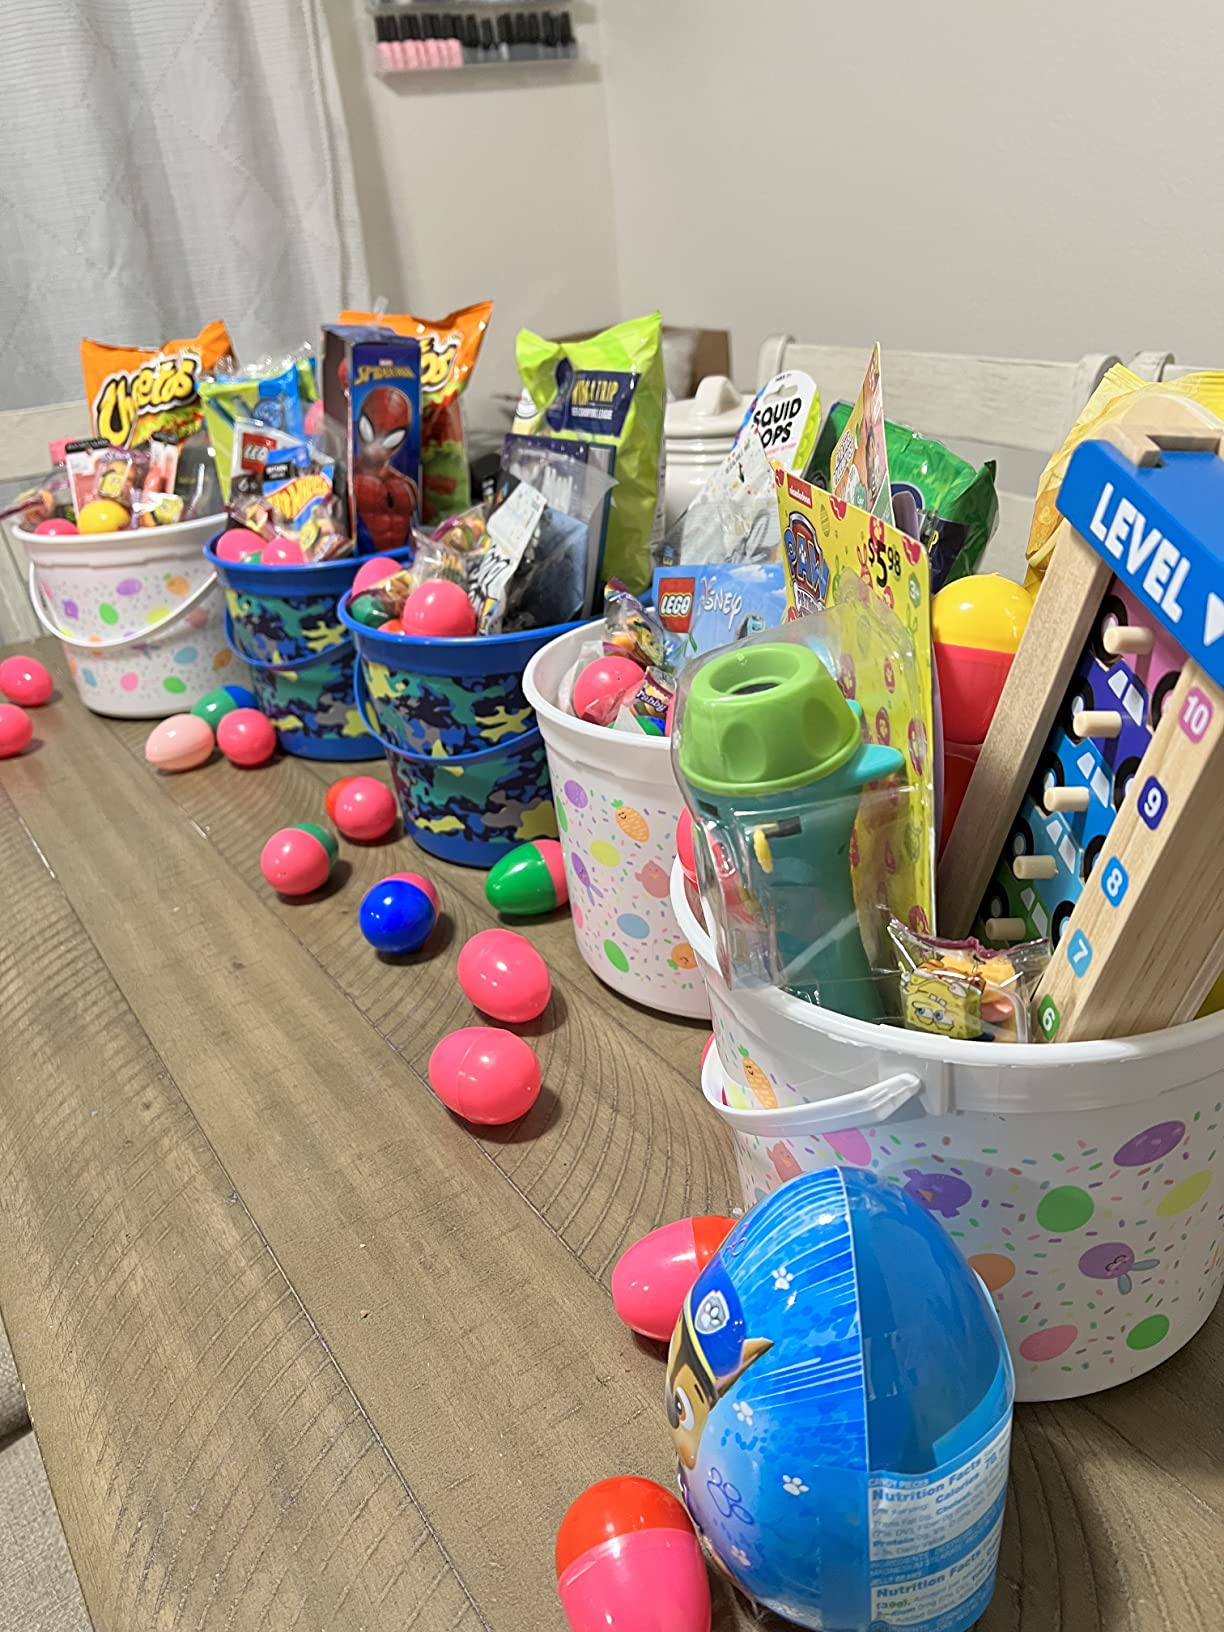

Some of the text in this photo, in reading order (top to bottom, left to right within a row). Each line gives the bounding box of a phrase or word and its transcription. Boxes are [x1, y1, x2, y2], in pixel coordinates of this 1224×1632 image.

[752, 397, 802, 428] SQUID
[761, 421, 793, 449] OPS
[1090, 482, 1191, 624] LEVEL
[661, 594, 691, 615] LEGO
[1184, 697, 1208, 726] 10
[1145, 792, 1162, 818] 9
[1107, 869, 1122, 891] 8
[1073, 941, 1088, 963] 7
[1042, 1007, 1056, 1032] 6
[872, 1483, 945, 1501] Nutrition
[949, 1458, 981, 1485] Facts
[876, 1575, 945, 1598] Nutrition
